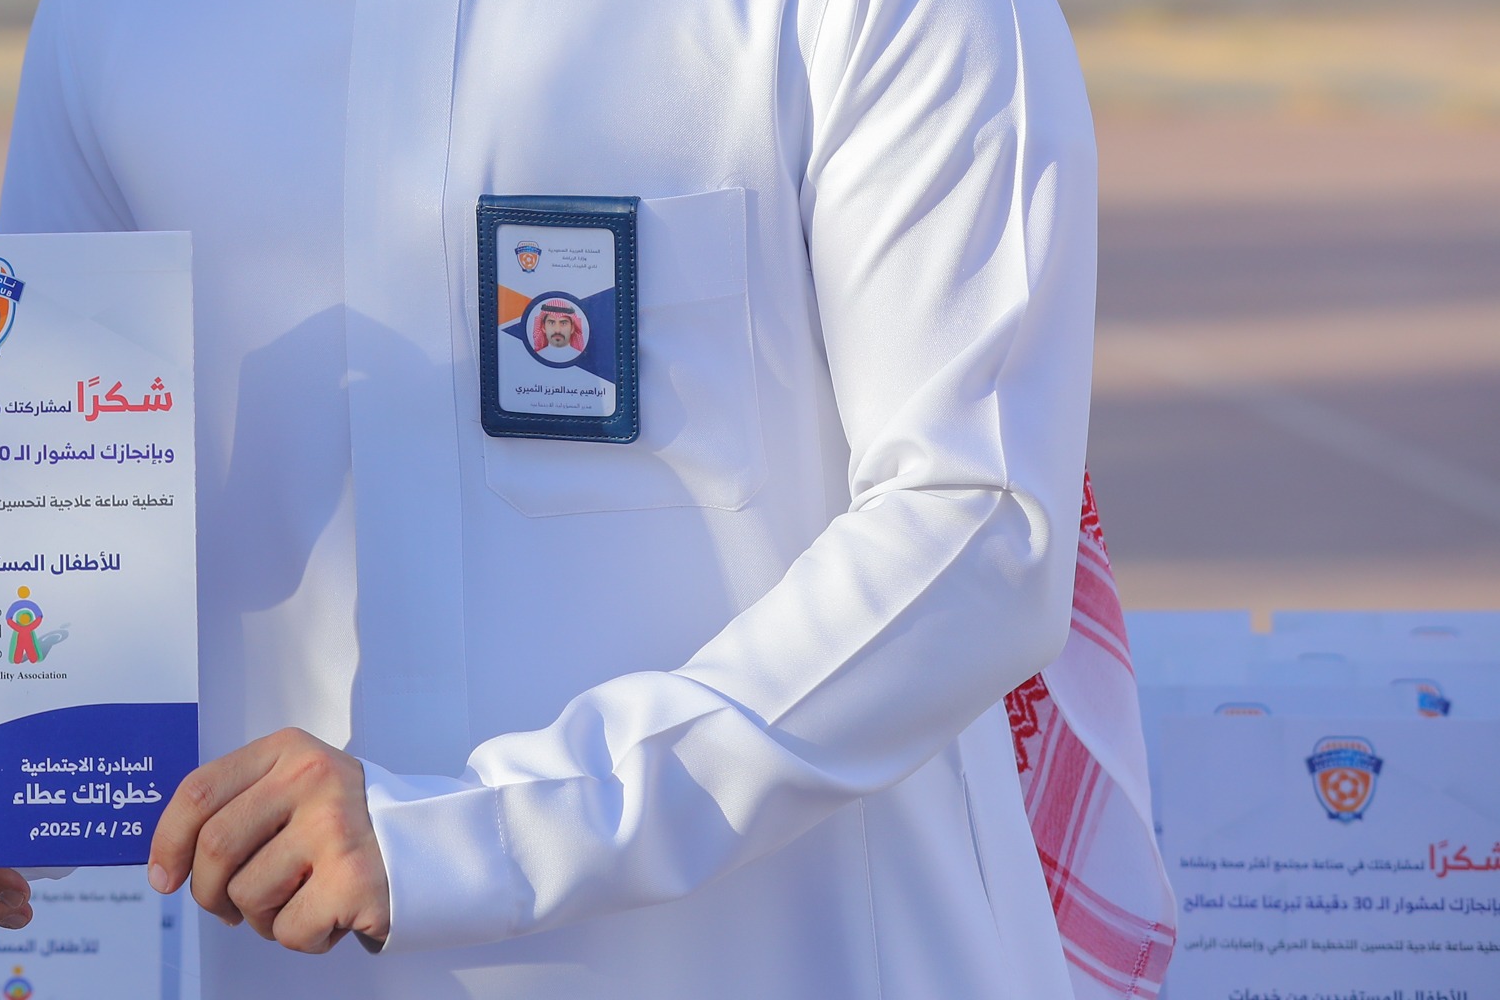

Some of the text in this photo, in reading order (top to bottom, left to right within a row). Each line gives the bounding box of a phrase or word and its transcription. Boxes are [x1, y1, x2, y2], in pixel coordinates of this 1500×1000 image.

[5, 400, 71, 416] لمشاركتك
[78, 376, 172, 421] شكرًا
[35, 443, 94, 464] لمشوار
[101, 443, 174, 464] وبإنجازك
[50, 495, 91, 511] علاجية
[95, 495, 128, 506] ساعة
[133, 494, 174, 510] تغطية
[51, 552, 120, 575] للأطفال
[17, 671, 68, 680] Association
[21, 756, 153, 777] المبادرة الاجتماعية
[12, 782, 162, 810] خطواتك عطاء
[29, 821, 142, 840] 26 / 4 / 2025م
[1449, 895, 1500, 916] بإنجازك
